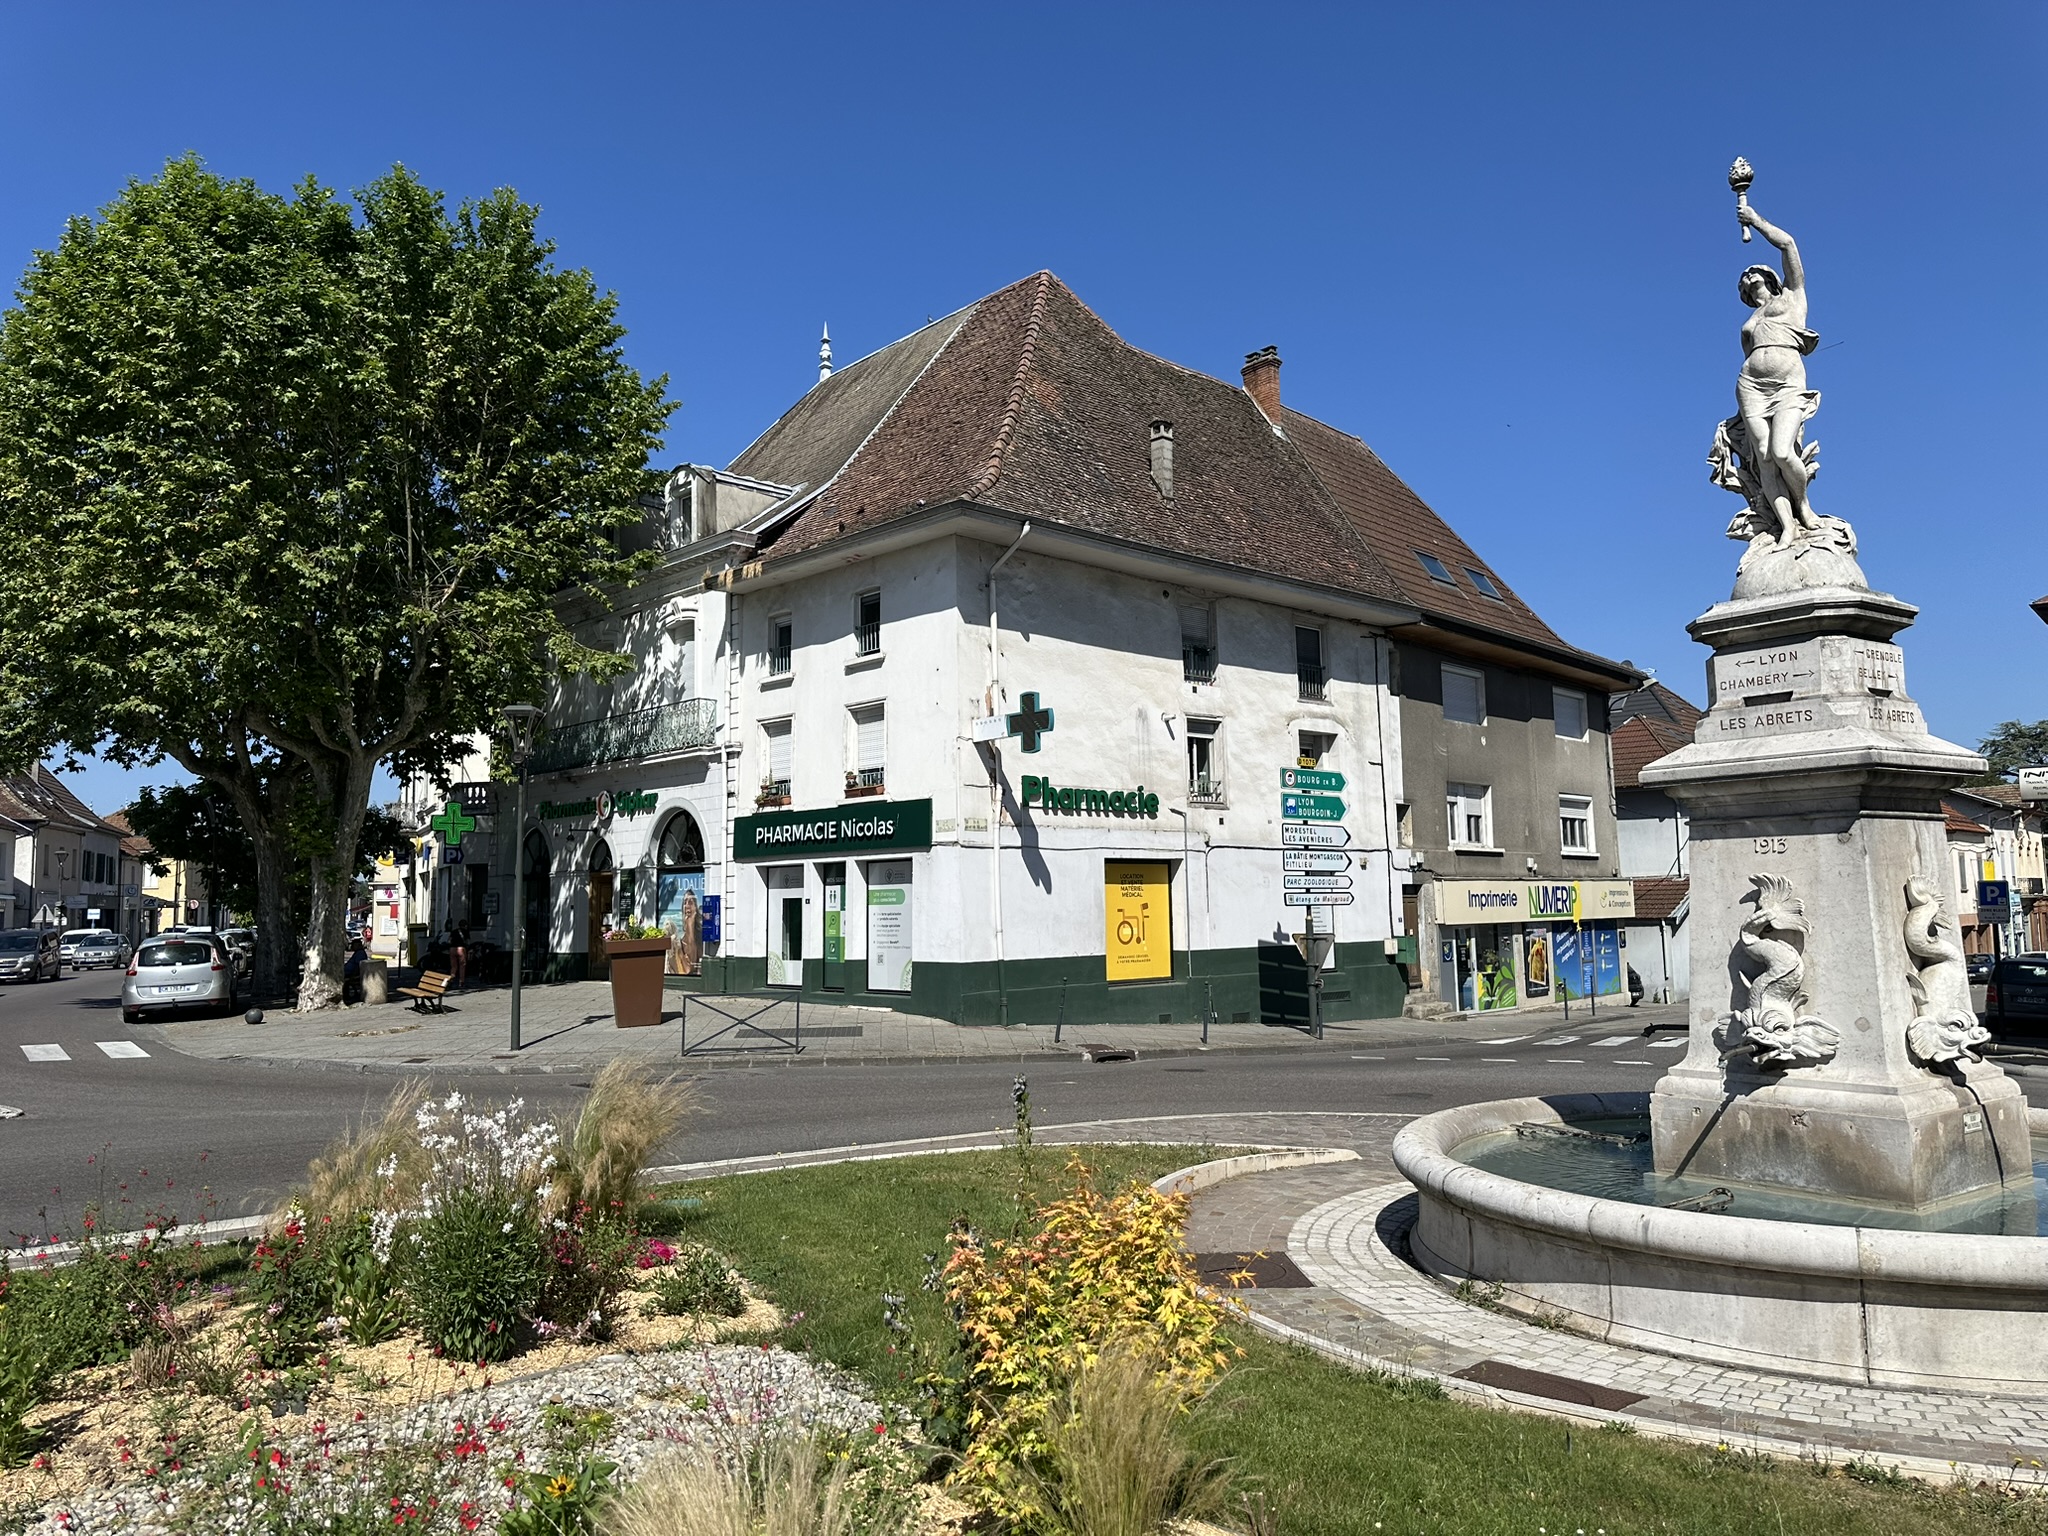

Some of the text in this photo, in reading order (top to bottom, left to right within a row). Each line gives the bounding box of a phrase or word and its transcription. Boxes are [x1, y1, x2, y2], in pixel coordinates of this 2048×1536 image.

[1759, 651, 1798, 665] LYON
[1866, 649, 1902, 663] GRENOBLE
[1859, 667, 1885, 680] BELLEY
[1720, 672, 1788, 691] CHAMBERY
[1720, 710, 1813, 730] LES ABRETS
[1868, 706, 1914, 723] LES ABRETS
[1297, 775, 1320, 785] BOURG
[1021, 775, 1159, 814] Pharmacie
[1298, 797, 1314, 806] LYON
[540, 788, 658, 820] Pharmacie Giphar
[756, 816, 894, 844] PHARMACIE Nicolas
[1284, 827, 1317, 835] MORESTEL
[1299, 836, 1333, 844] AVENIÈRES
[446, 849, 457, 860] P
[1294, 852, 1308, 860] BÂTIE
[1468, 889, 1518, 911] Imprimerie
[1986, 885, 2000, 902] P
